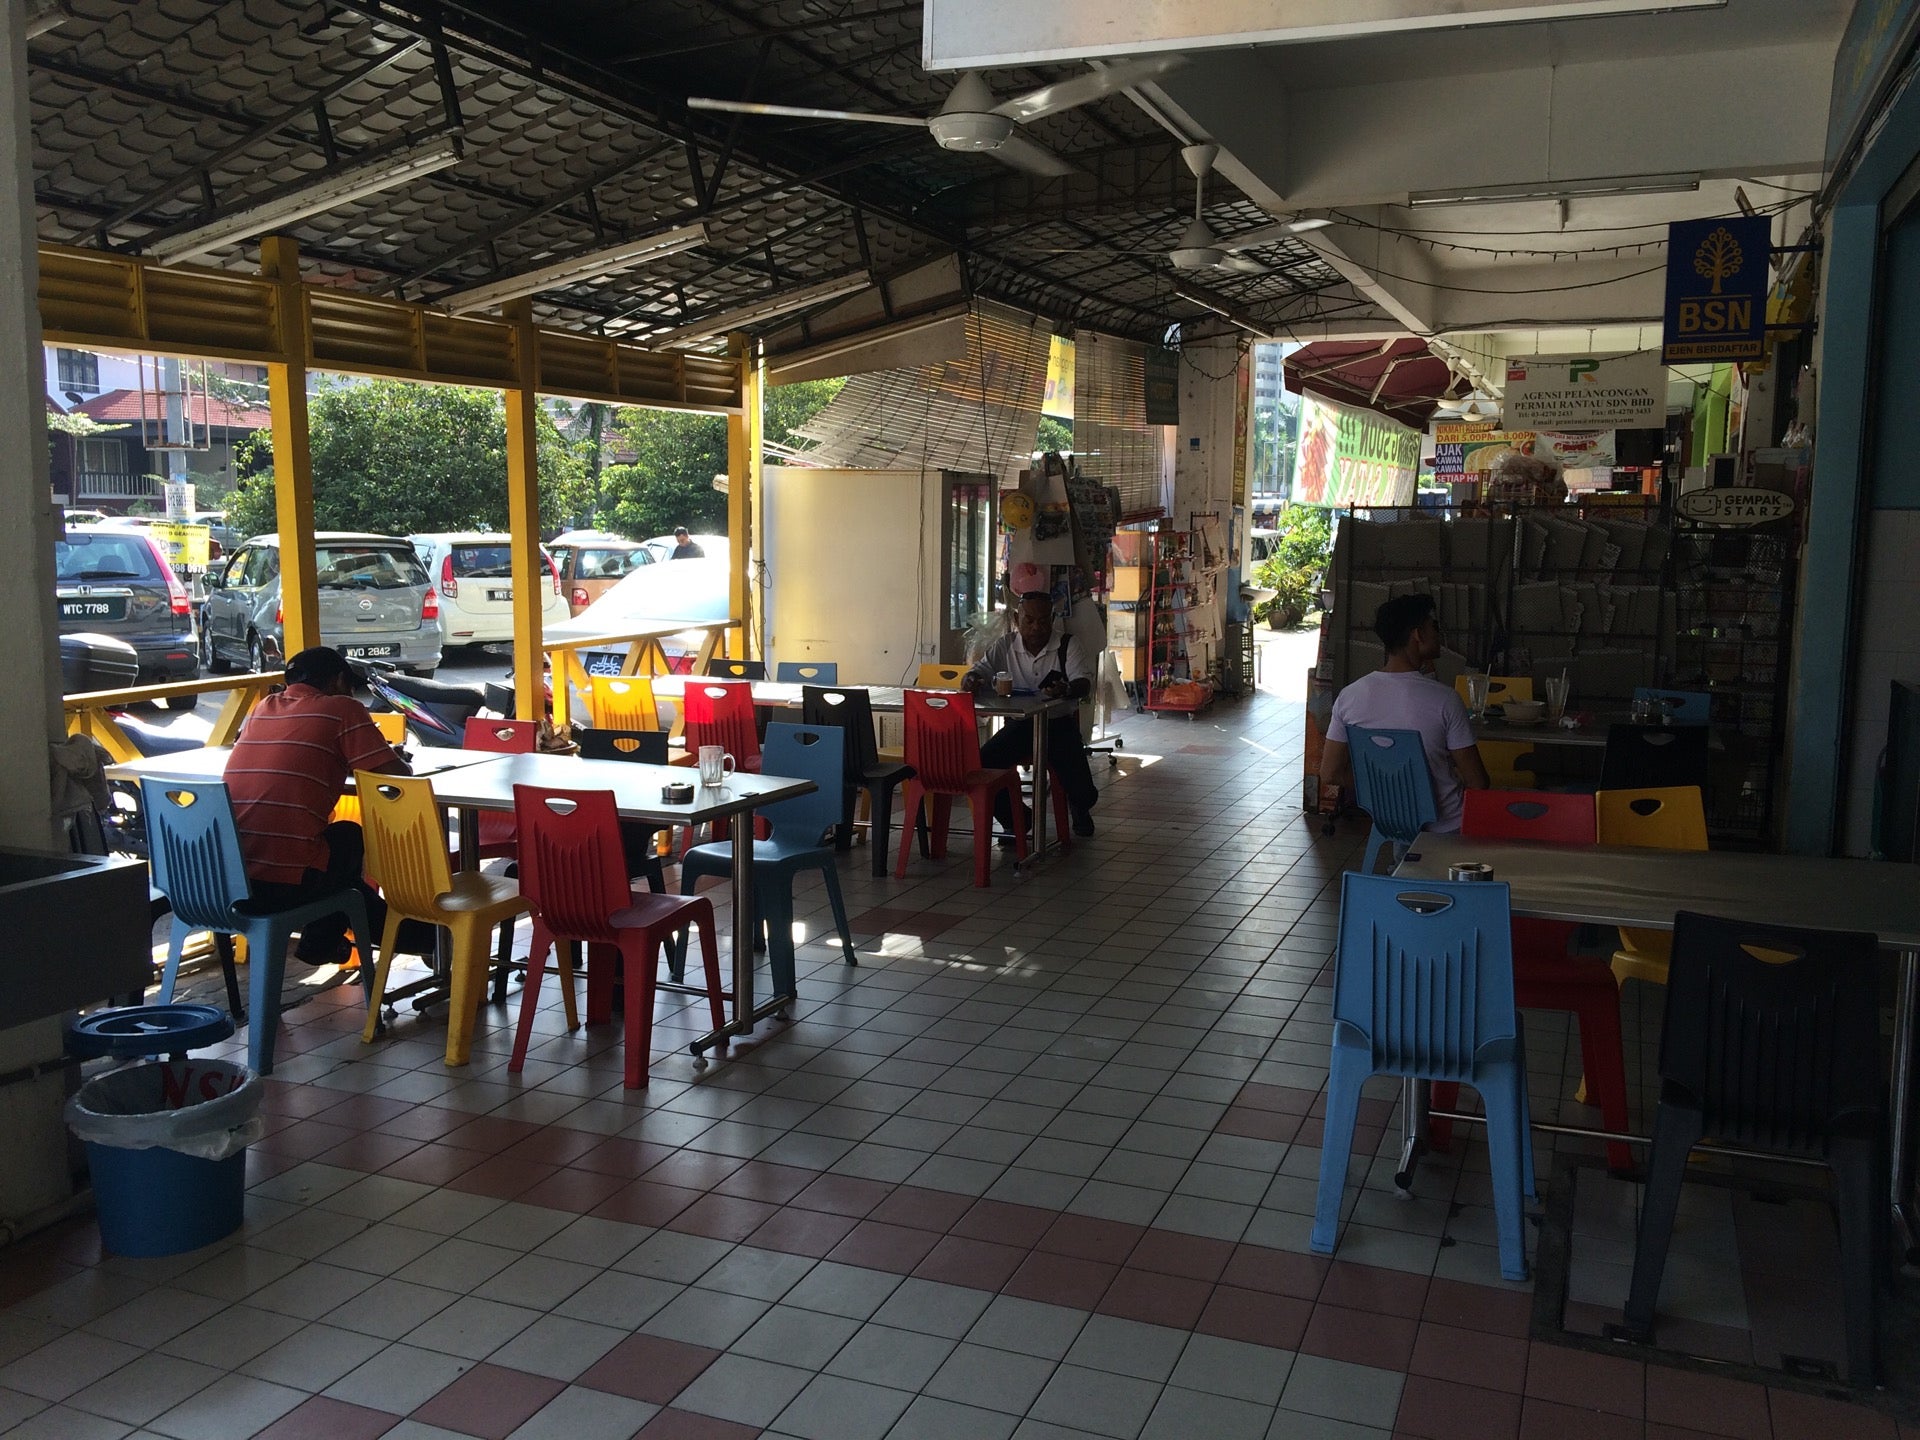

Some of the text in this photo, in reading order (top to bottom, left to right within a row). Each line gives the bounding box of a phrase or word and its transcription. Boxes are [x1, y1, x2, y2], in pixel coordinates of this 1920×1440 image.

[1679, 301, 1751, 332] BSN
[1669, 343, 1757, 355] EJEN BERDAFTAR
[1522, 388, 1649, 400] AGENSI PELANCONGAN
[1514, 398, 1655, 410] PERMAI RANTAU SDN BHD
[1437, 434, 1458, 443] DARI
[1436, 444, 1462, 456] AJAK
[1436, 456, 1463, 465] KAWAN
[1435, 464, 1463, 473] KAWAN
[1437, 474, 1465, 483] SETIAP
[1724, 495, 1781, 505] GEMPAK
[63, 603, 109, 614] WTC 7788
[367, 647, 391, 656] 2842
[596, 654, 620, 666] JLC
